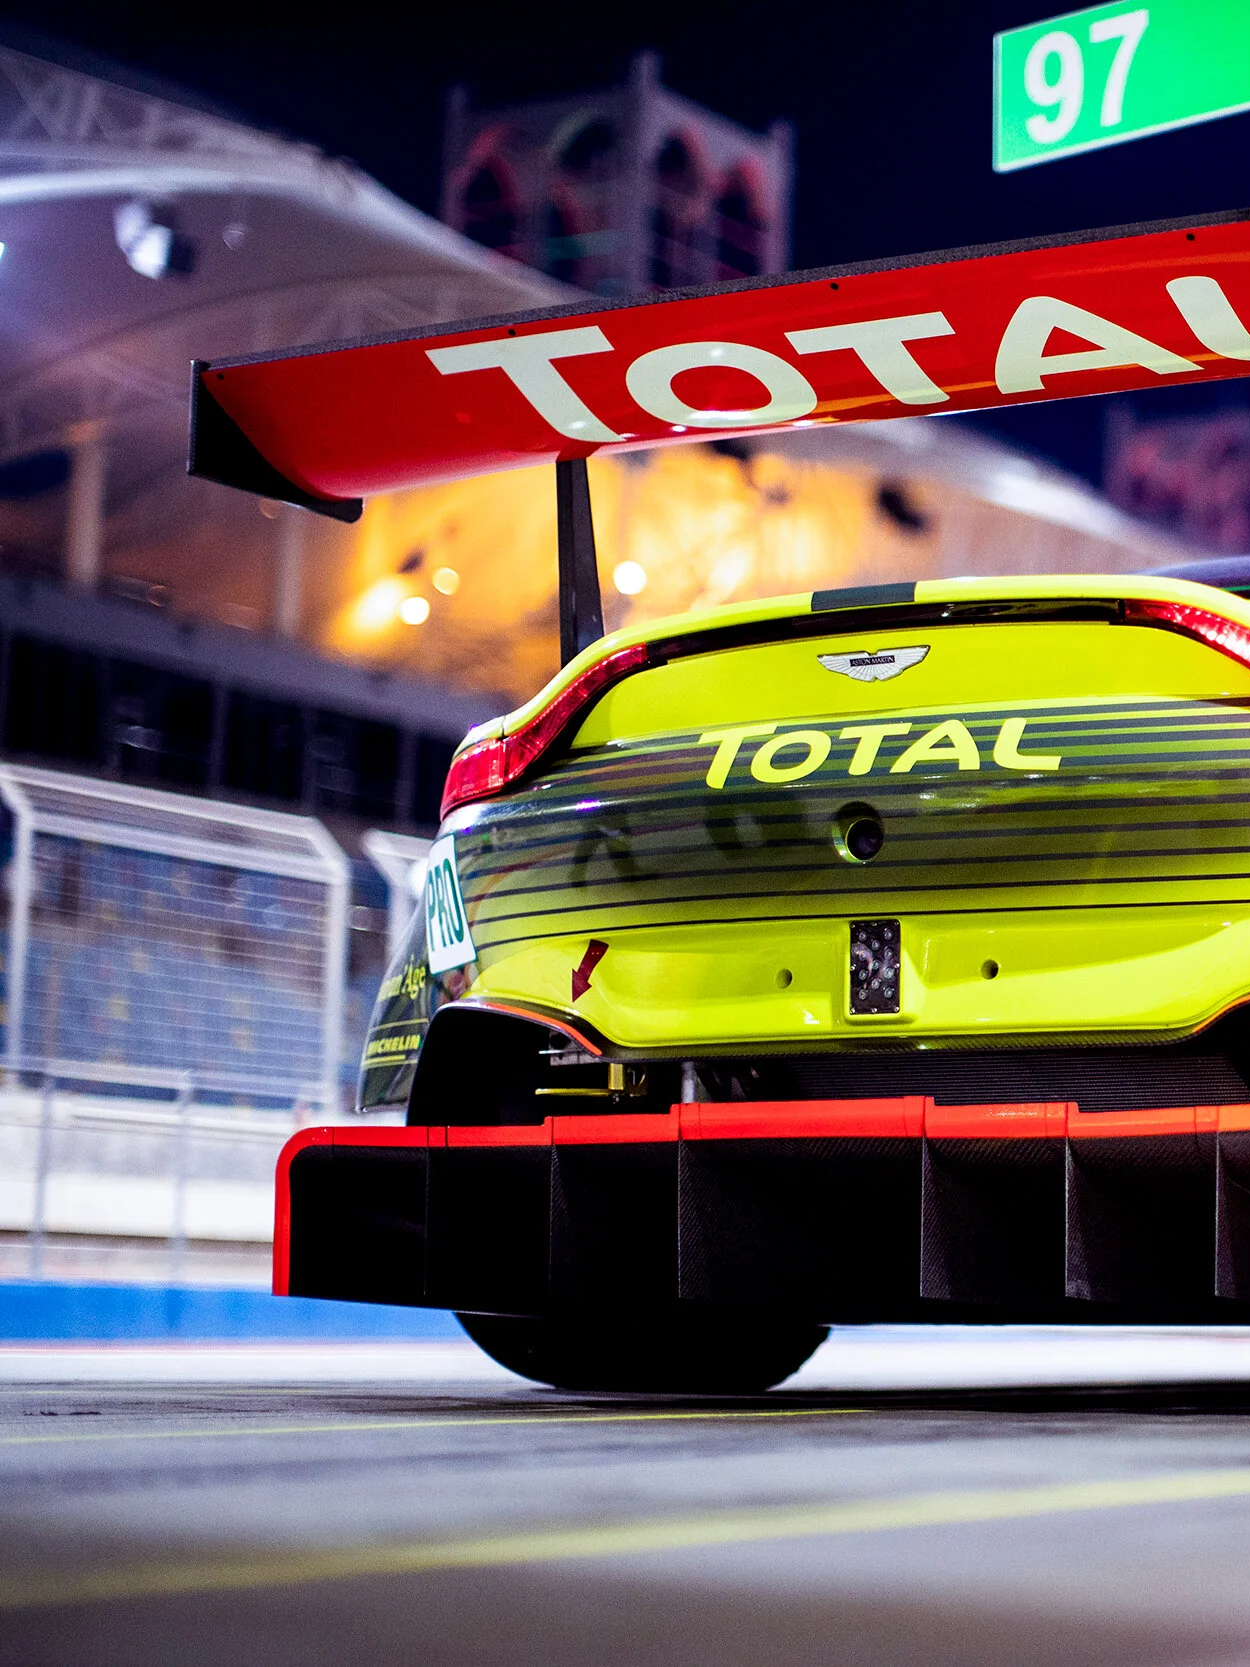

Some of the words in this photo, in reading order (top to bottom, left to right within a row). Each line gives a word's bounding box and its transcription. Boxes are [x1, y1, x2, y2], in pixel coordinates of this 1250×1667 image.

[1024, 8, 1149, 145] 97
[851, 658, 871, 667] ASTON
[872, 656, 894, 664] MARTIN
[697, 717, 1062, 790] TOTAL
[427, 857, 465, 952] PRO
